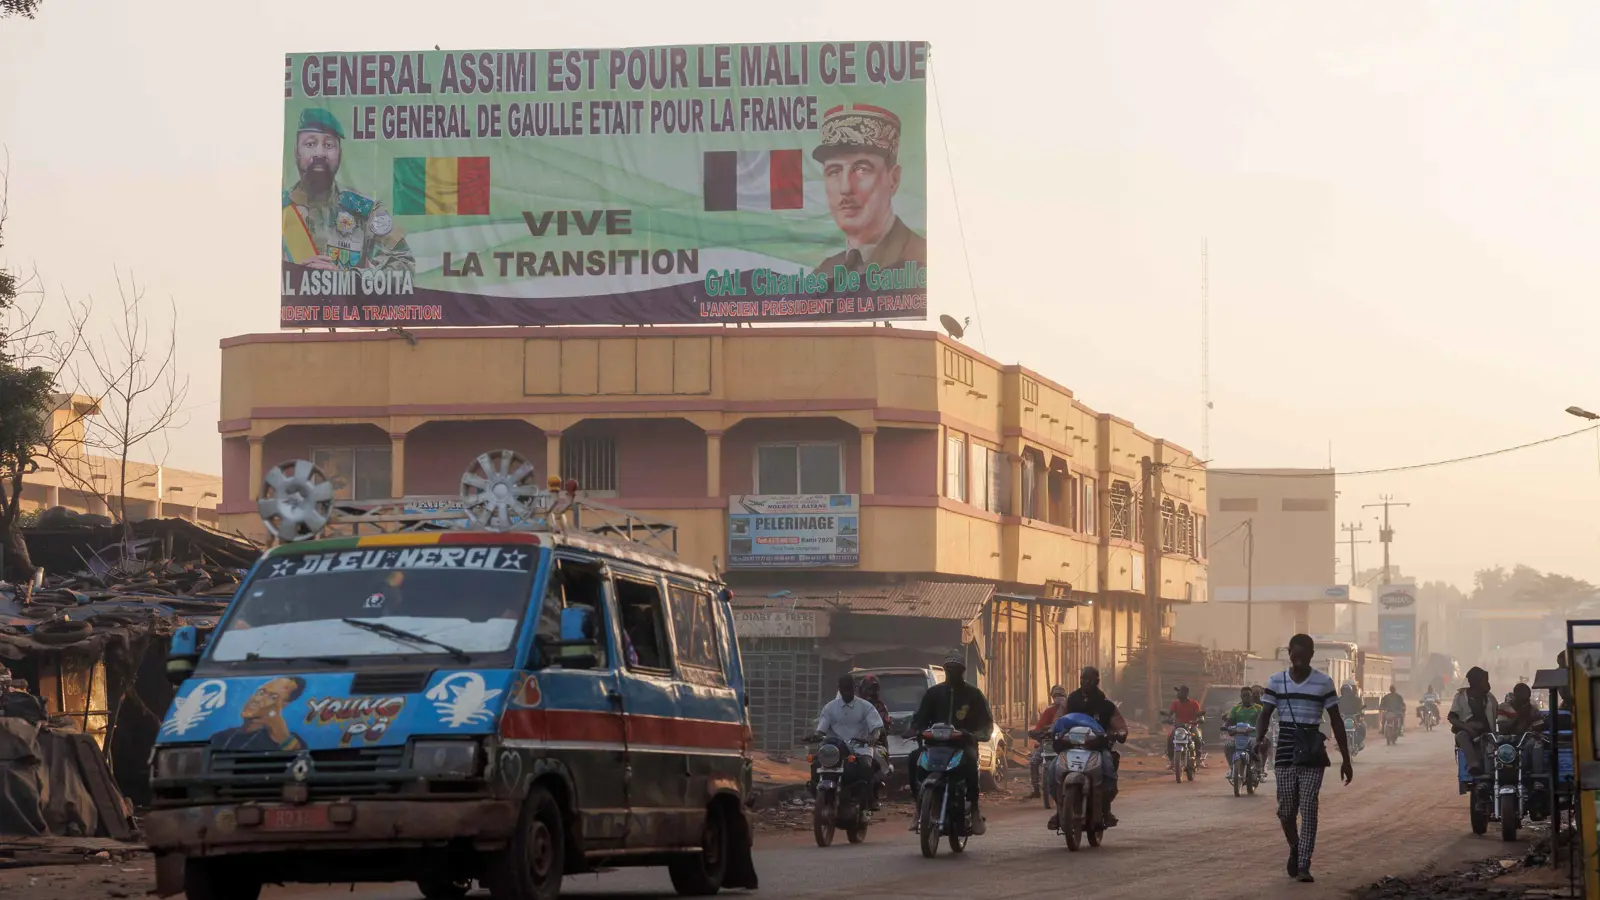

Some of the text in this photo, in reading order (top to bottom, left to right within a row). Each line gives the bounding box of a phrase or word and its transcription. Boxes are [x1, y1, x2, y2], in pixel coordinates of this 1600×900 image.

[302, 53, 432, 97] GENERAL
[440, 51, 537, 94] ASSIMI
[548, 50, 600, 92] EST
[609, 47, 688, 90] POUR
[698, 46, 732, 87] LE
[741, 44, 808, 86] MALI
[819, 42, 856, 84] CE
[866, 42, 925, 85] QUE
[353, 96, 818, 139] LE GENERAL DE GAULLE ETAIT POUR LA FRANCE
[522, 209, 632, 237] VIVE
[443, 249, 699, 277] LA TRANSITION
[299, 270, 356, 296] ASSIMI
[361, 270, 414, 295] GOITA
[705, 260, 927, 297] GAL Charles De Gaulle
[323, 305, 340, 320] DE
[343, 305, 360, 321] LA
[362, 304, 442, 321] TRANSITION
[700, 294, 927, 317] L'ANCIEN PRÉSIDENT DE LA FRANCE
[755, 517, 834, 530] PELERINAGE
[296, 550, 387, 576] DIEU
[775, 613, 782, 621] &
[304, 696, 406, 723] YOUNG
